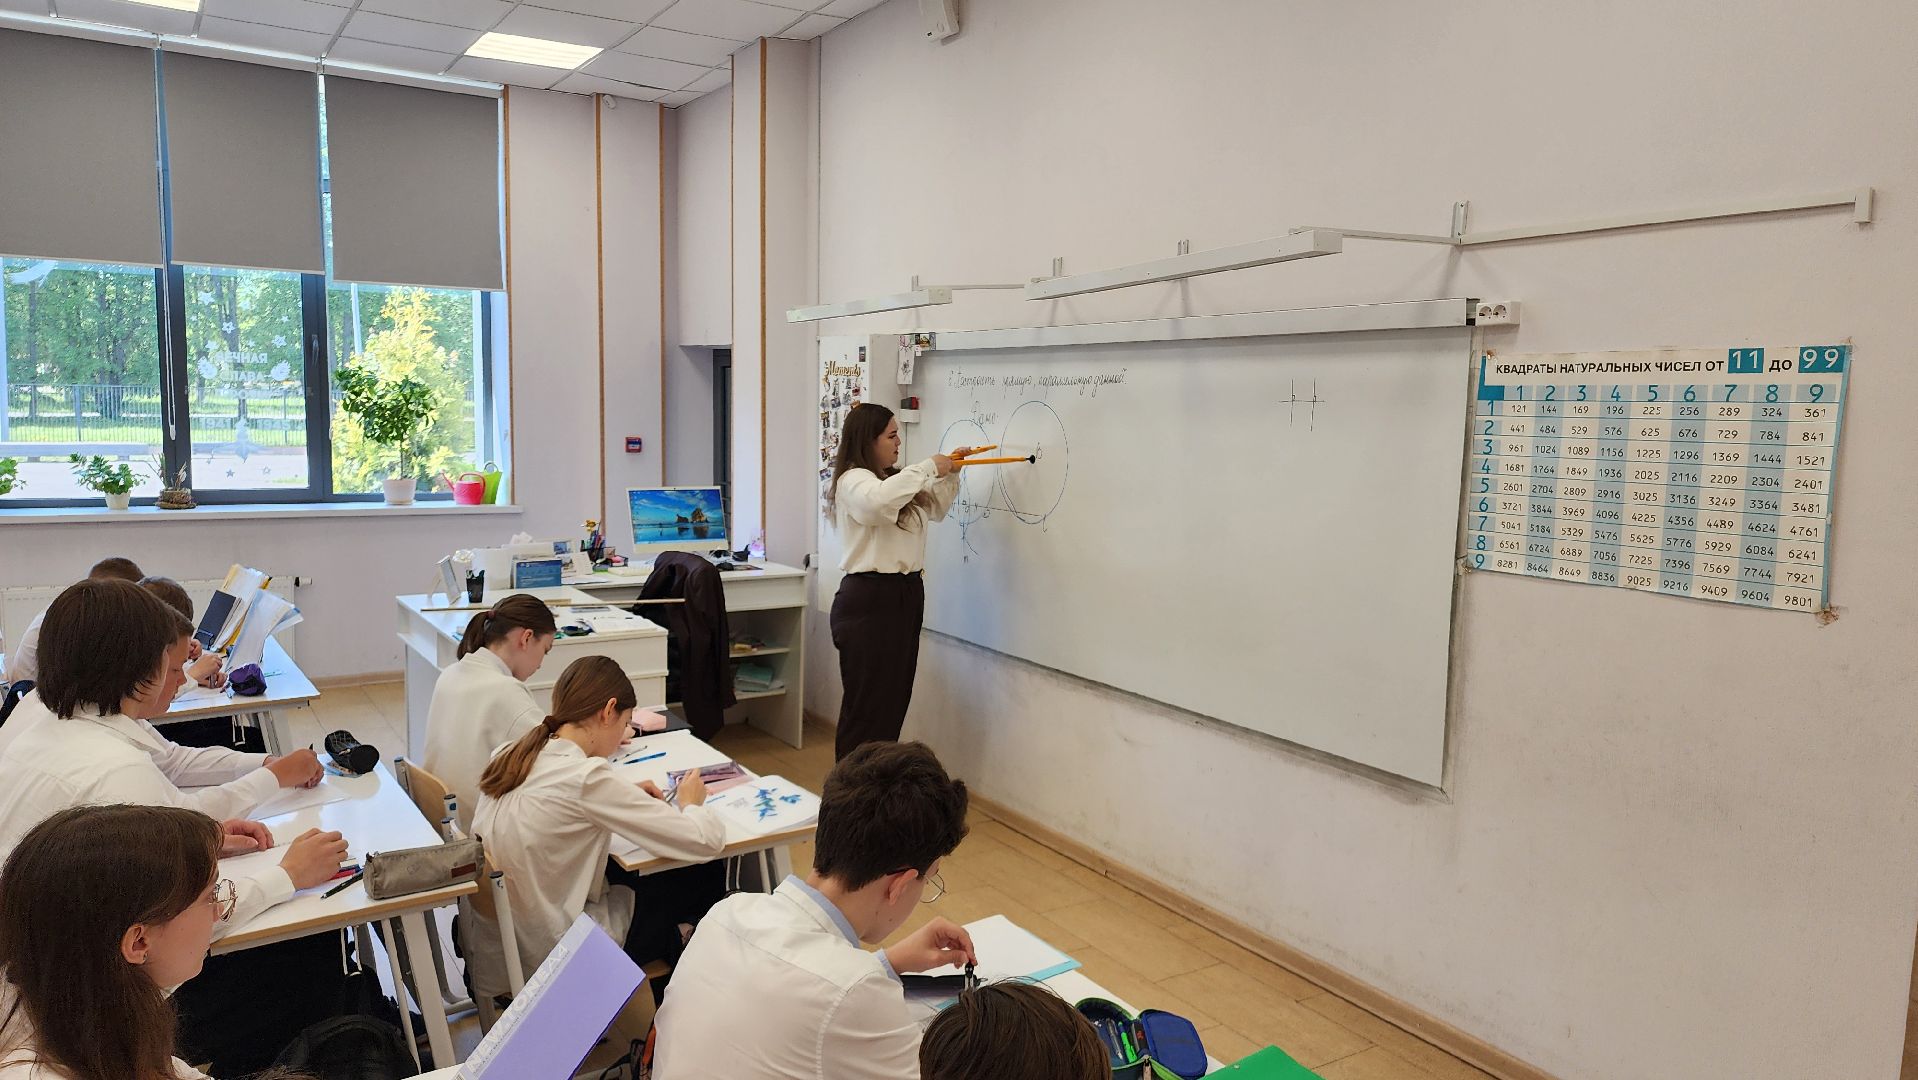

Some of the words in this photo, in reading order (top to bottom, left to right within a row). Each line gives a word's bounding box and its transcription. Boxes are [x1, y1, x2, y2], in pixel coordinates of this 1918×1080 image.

[1496, 363, 1557, 376] КВАДРАТЫ
[1560, 362, 1652, 374] НАТУРАЛЬНЫХ
[1655, 361, 1701, 372] ЧИСЕЛ
[1705, 360, 1724, 372] ОТ
[1732, 350, 1759, 369] 11
[1769, 359, 1792, 372] ДО
[1802, 348, 1839, 369] 99
[1488, 400, 1494, 416] 1
[1511, 404, 1526, 413] 121
[1541, 405, 1557, 414] 144
[1573, 405, 1589, 414] 169
[1606, 405, 1624, 415] 196
[1642, 406, 1661, 415] 225
[1679, 406, 1700, 416] 256
[1718, 406, 1741, 417] 289
[1761, 407, 1782, 417] 324
[1804, 408, 1826, 418] 361
[1516, 385, 1523, 401] 1
[1545, 385, 1556, 401] 2
[1576, 385, 1586, 401] 3
[1611, 385, 1621, 401] 4
[1648, 385, 1658, 402] 5
[1684, 385, 1696, 402] 6
[1724, 384, 1737, 402] 7
[1766, 384, 1779, 403] 8
[1809, 384, 1824, 403] 9
[1484, 420, 1494, 435] 2
[1510, 424, 1525, 433] 441
[1539, 425, 1556, 434] 484
[1571, 426, 1588, 435] 529
[1604, 426, 1622, 436] 576
[1641, 427, 1660, 437] 625
[1678, 428, 1698, 438] 676
[1718, 429, 1738, 439] 729
[1759, 430, 1780, 441] 784
[1802, 432, 1824, 442] 841
[1483, 439, 1492, 455] 3
[1508, 444, 1524, 453] 961
[1535, 445, 1556, 454] 1024
[1567, 446, 1590, 456] 1089
[1601, 447, 1624, 458] 1156
[1636, 449, 1661, 458] 1225
[1673, 450, 1699, 460] 1296
[1712, 452, 1740, 462] 1369
[1754, 453, 1782, 464] 1444
[1796, 455, 1825, 466] 1521
[1482, 458, 1491, 474] 4
[1505, 463, 1524, 472] 1681
[1533, 465, 1555, 474] 1764
[1566, 467, 1588, 476] 1849
[1599, 468, 1622, 479] 1936
[1634, 470, 1660, 481] 2025
[1671, 472, 1698, 483] 2116
[1710, 474, 1738, 485] 2209
[1751, 476, 1780, 487] 2304
[1794, 479, 1823, 490] 2401
[1481, 478, 1489, 493] 5
[1503, 482, 1523, 492] 2601
[1531, 484, 1554, 494] 2704
[1563, 486, 1587, 497] 2809
[1597, 489, 1621, 499] 2916
[1632, 491, 1658, 502] 3025
[1669, 493, 1696, 505] 3136
[1708, 496, 1736, 507] 3249
[1749, 499, 1778, 510] 3364
[1792, 502, 1820, 514] 3481
[1479, 497, 1488, 512] 6
[1502, 502, 1522, 511] 3721
[1531, 504, 1552, 514] 3844
[1562, 506, 1585, 517] 3969
[1596, 510, 1620, 520] 4096
[1631, 512, 1656, 523] 4225
[1668, 515, 1694, 527] 4356
[1706, 518, 1734, 530] 4489
[1747, 522, 1776, 533] 4624
[1789, 525, 1818, 538] 4761
[1479, 516, 1488, 531] 7
[1501, 521, 1521, 531] 5041
[1529, 523, 1551, 534] 5184
[1561, 527, 1584, 537] 5329
[1594, 530, 1618, 541] 5476
[1630, 533, 1654, 544] 5625
[1666, 537, 1692, 548] 5776
[1705, 540, 1732, 552] 5929
[1745, 544, 1774, 557] 6084
[1788, 549, 1816, 561] 6241
[1477, 535, 1486, 550] 8
[1499, 540, 1520, 550] 6561
[1528, 543, 1550, 554] 6724
[1560, 547, 1583, 557] 6889
[1593, 550, 1617, 562] 7056
[1629, 554, 1653, 565] 7225
[1665, 558, 1691, 570] 7396
[1703, 562, 1730, 575] 7569
[1743, 567, 1772, 579] 7744
[1787, 572, 1814, 584] 7921
[1475, 554, 1485, 569] 9
[1497, 559, 1518, 569] 8281
[1526, 562, 1549, 574] 8464
[1558, 566, 1581, 577] 8649
[1591, 571, 1615, 582] 8836
[1627, 575, 1651, 587] 9025
[1663, 580, 1689, 592] 9216
[1701, 585, 1728, 597] 9409
[1741, 589, 1770, 602] 9604
[1784, 595, 1812, 608] 9801
